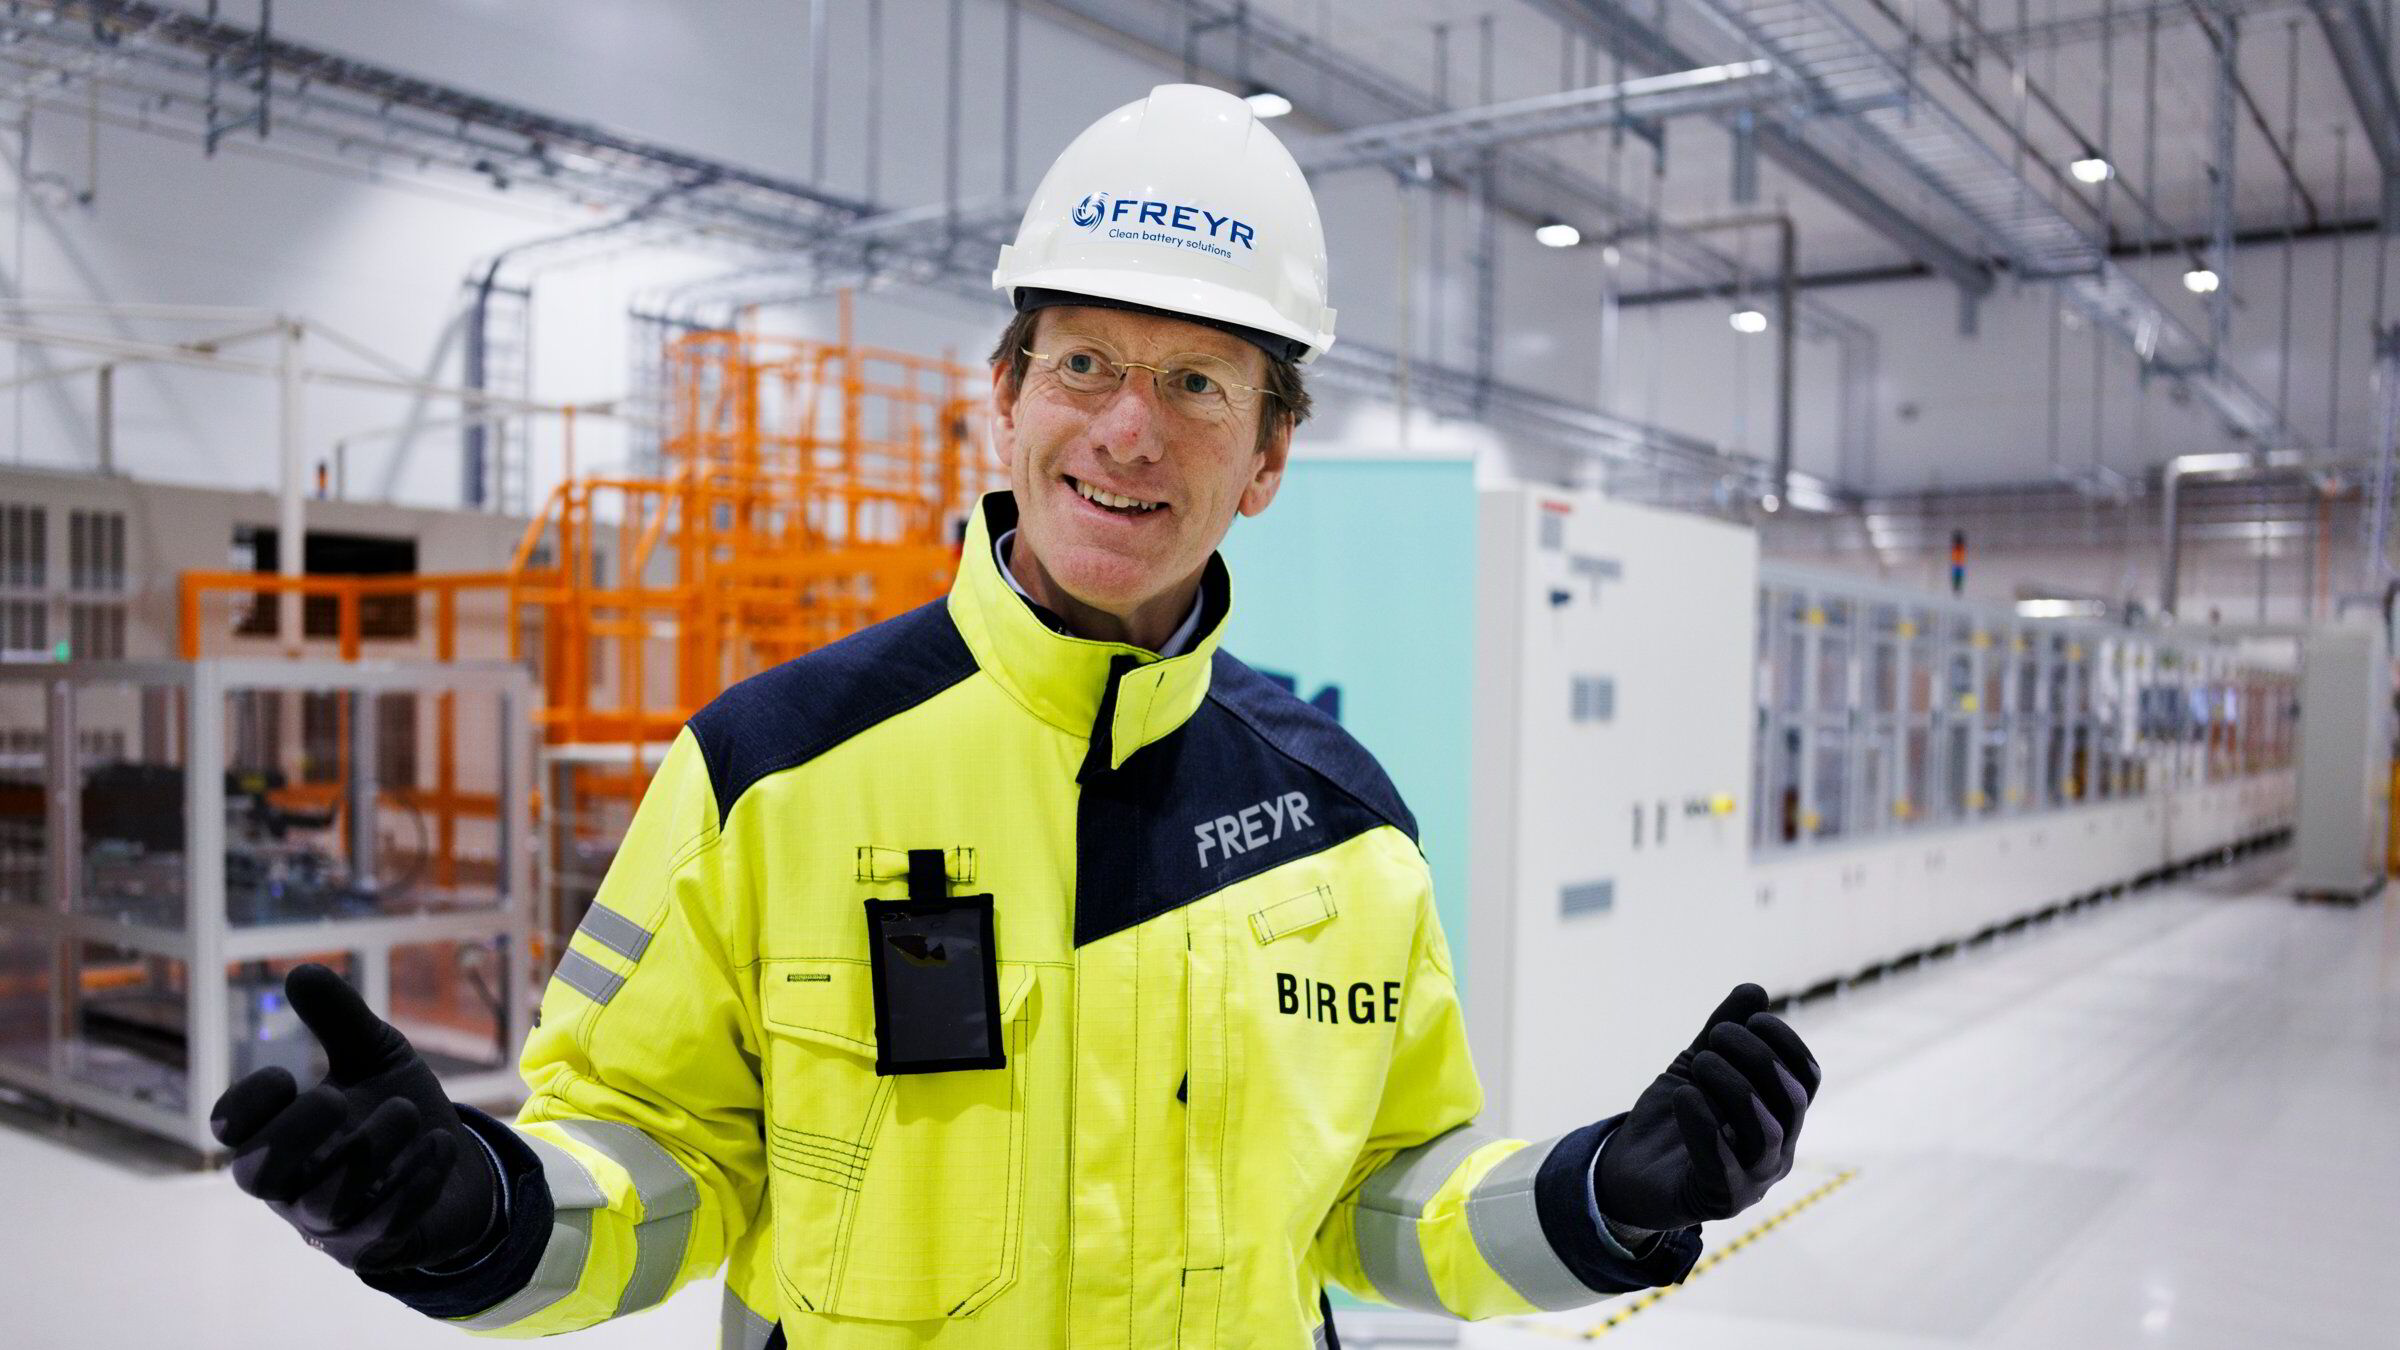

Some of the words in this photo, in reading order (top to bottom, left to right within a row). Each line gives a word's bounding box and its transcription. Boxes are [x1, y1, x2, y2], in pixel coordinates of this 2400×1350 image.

[1108, 228, 1139, 240] Clean
[1142, 230, 1184, 248] battery
[1186, 240, 1232, 259] solutions
[1111, 199, 1255, 250] FREYR
[1193, 790, 1316, 869] FREYR
[1275, 972, 1401, 1025] BIRGE
